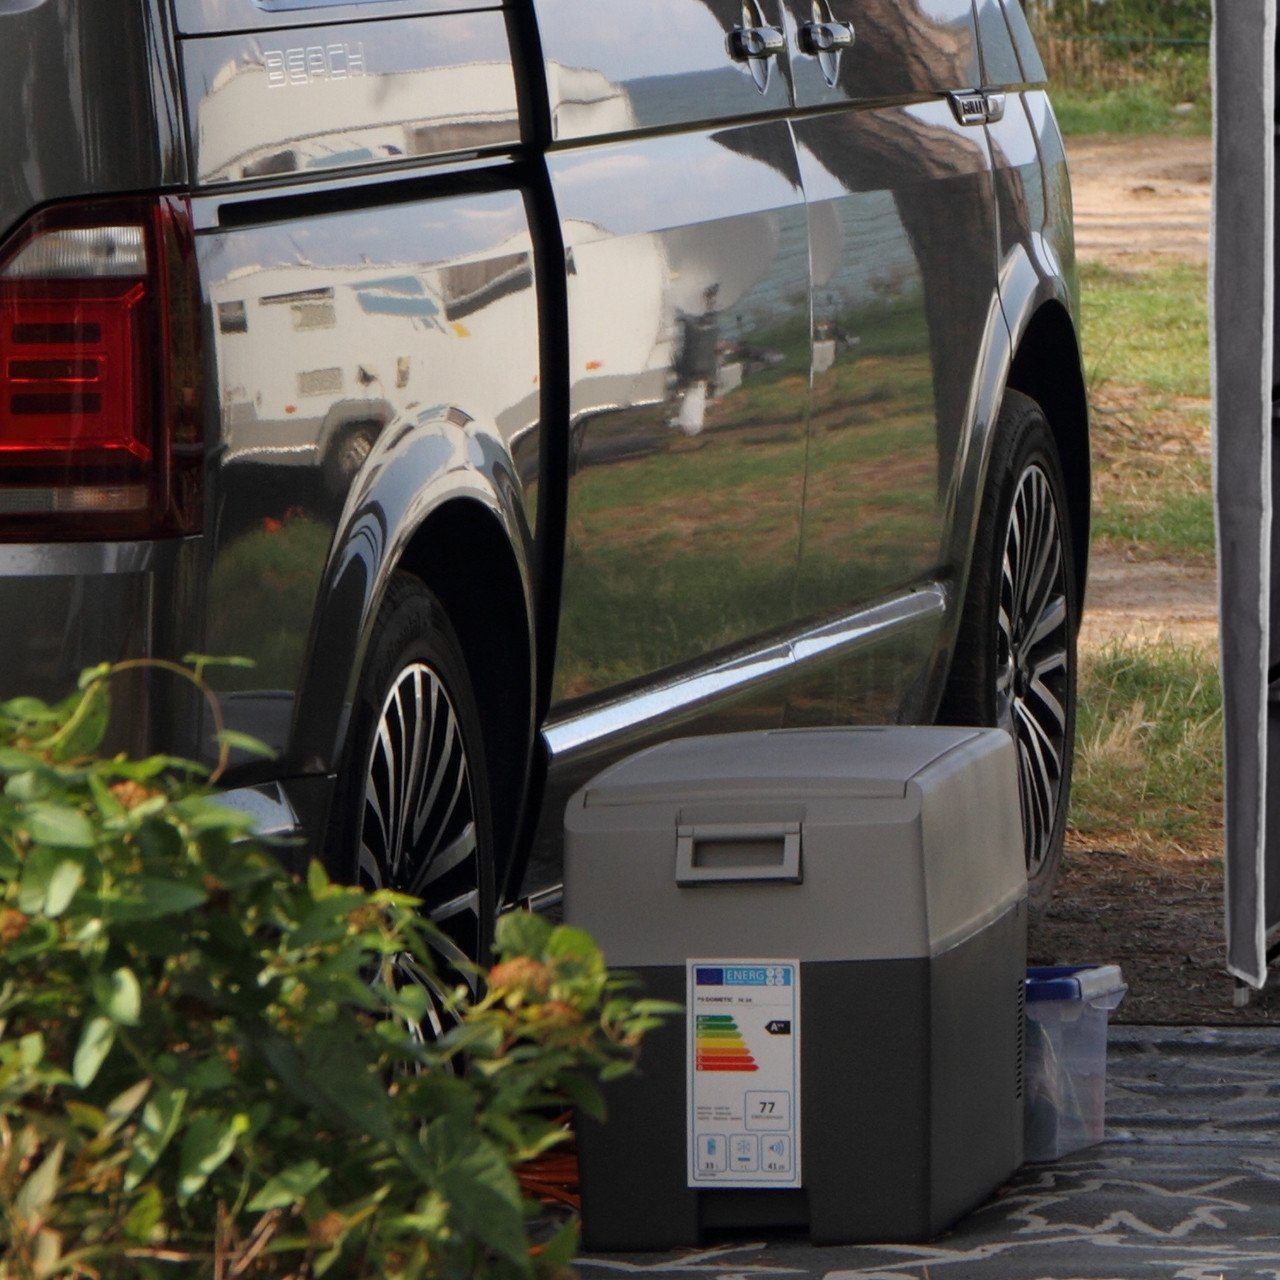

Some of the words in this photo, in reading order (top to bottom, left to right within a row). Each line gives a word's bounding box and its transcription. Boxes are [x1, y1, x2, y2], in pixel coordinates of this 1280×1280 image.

[264, 41, 367, 89] BEACH
[726, 970, 765, 980] ENERG
[759, 1101, 776, 1114] 77
